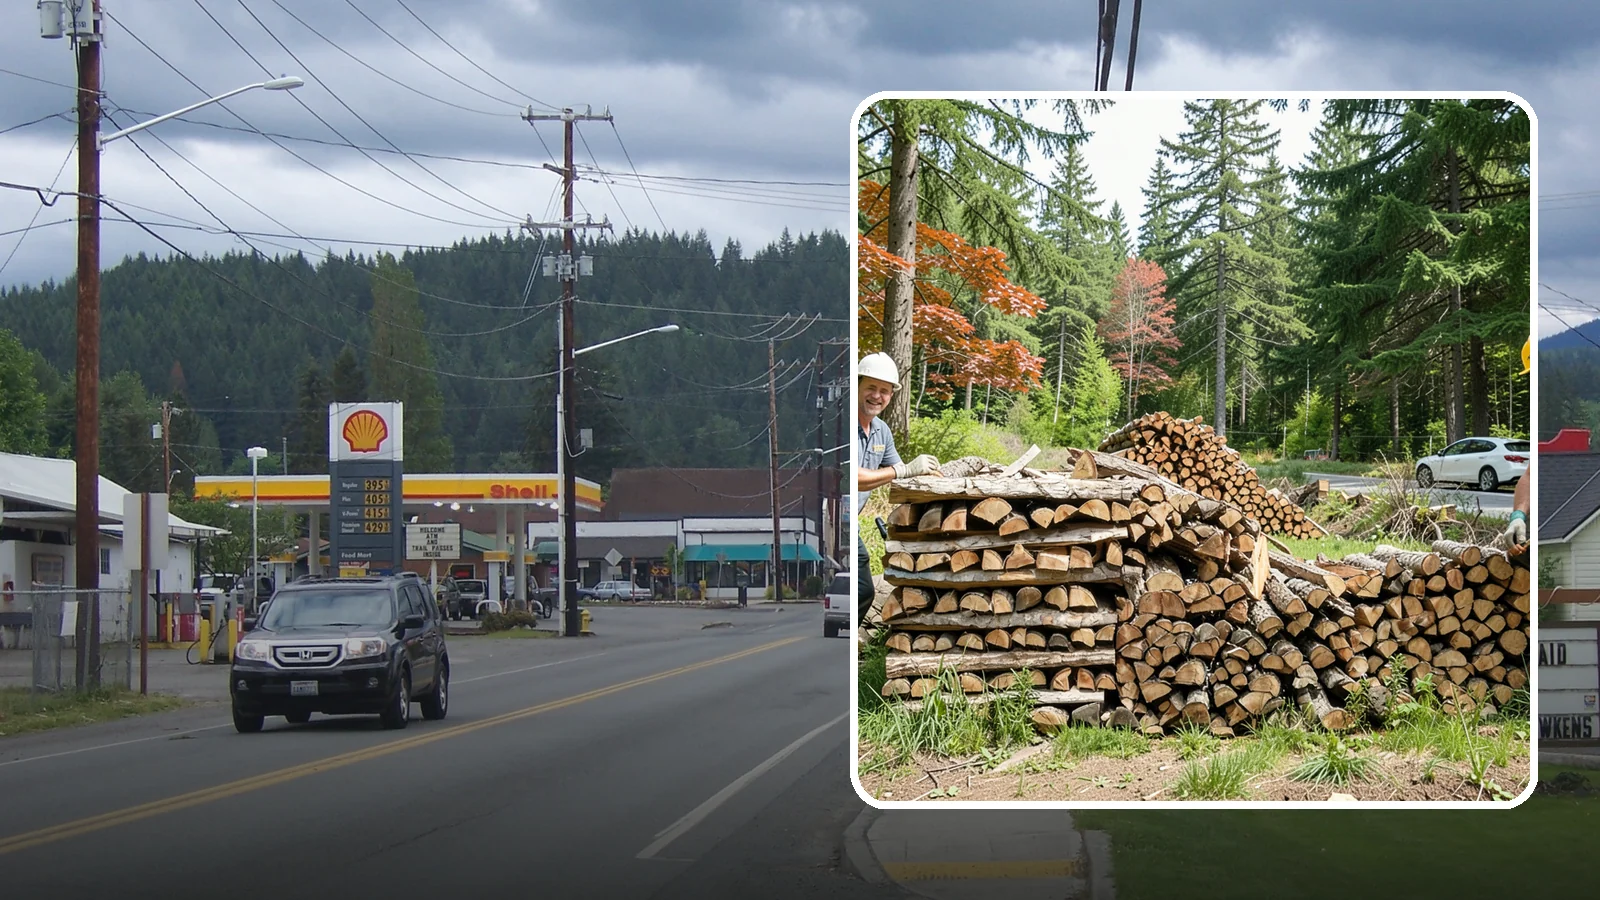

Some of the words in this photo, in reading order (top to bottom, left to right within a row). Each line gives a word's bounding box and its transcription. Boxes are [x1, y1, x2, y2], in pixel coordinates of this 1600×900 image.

[366, 480, 383, 490] 395
[490, 484, 547, 499] Shell
[365, 494, 384, 504] 405
[365, 508, 384, 518] 415
[365, 522, 384, 532] 429
[1539, 642, 1567, 666] AID
